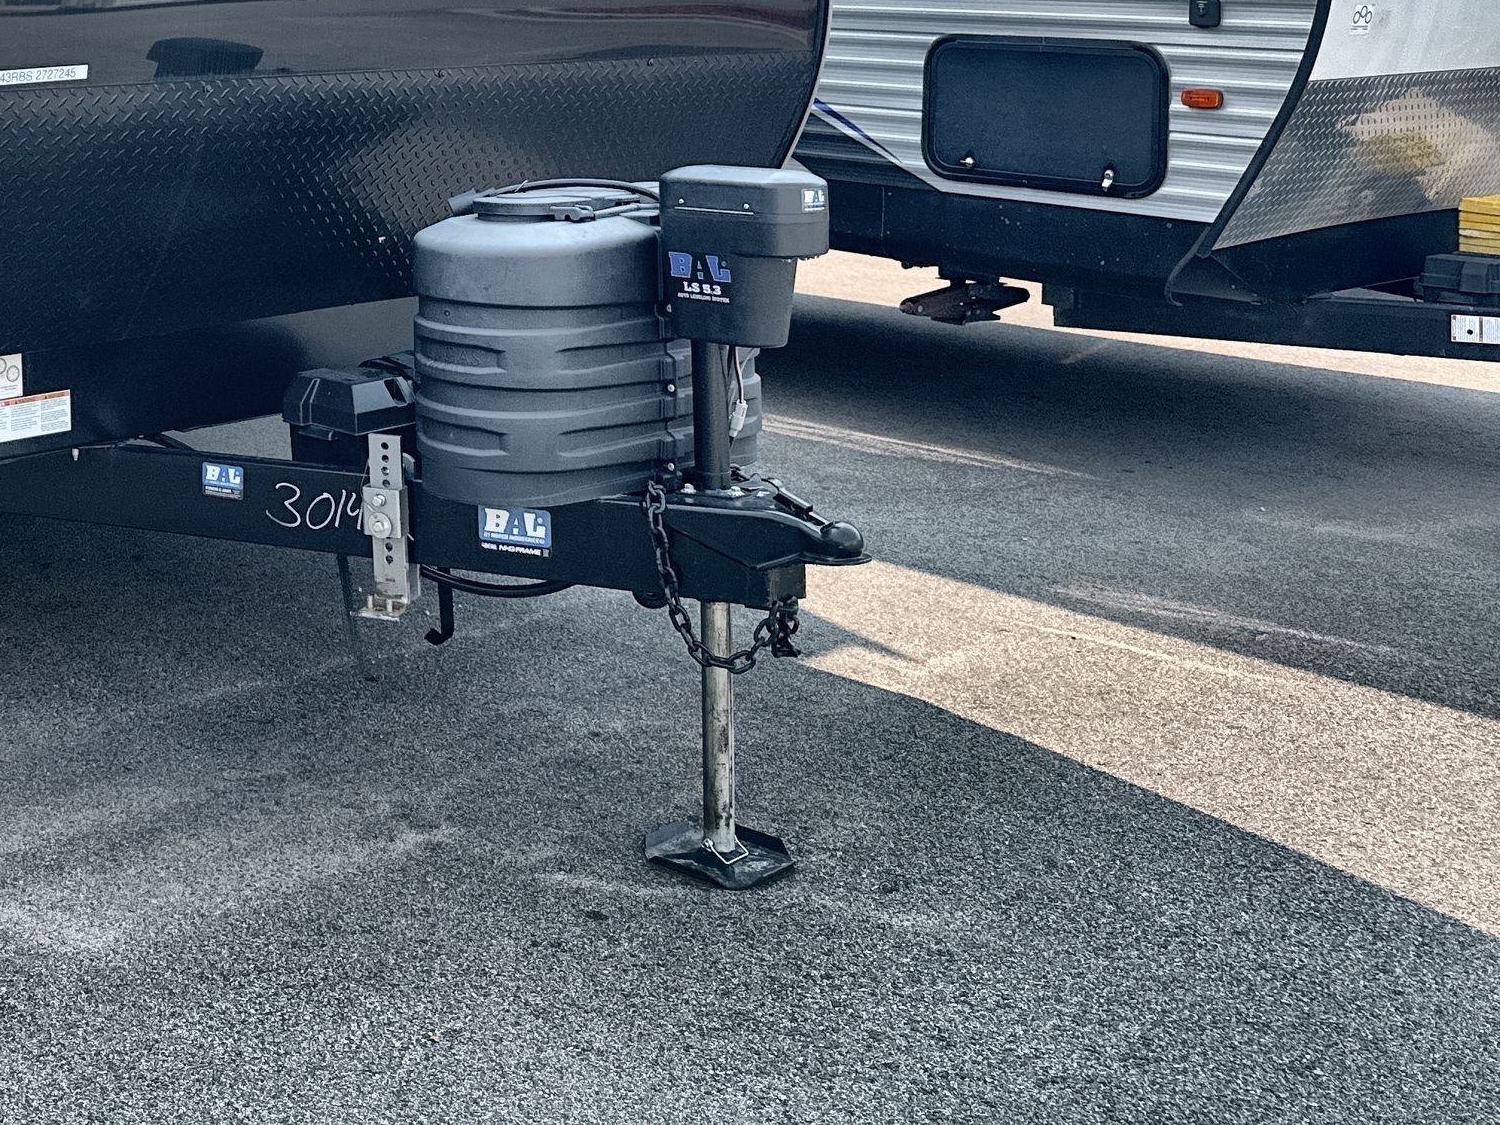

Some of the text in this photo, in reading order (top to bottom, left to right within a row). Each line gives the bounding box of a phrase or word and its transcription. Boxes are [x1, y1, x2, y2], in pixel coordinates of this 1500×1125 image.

[35, 68, 76, 81] 2727245
[668, 251, 732, 283] BAL
[682, 281, 700, 293] LS
[205, 465, 241, 484] BAL
[484, 507, 546, 538] BAL
